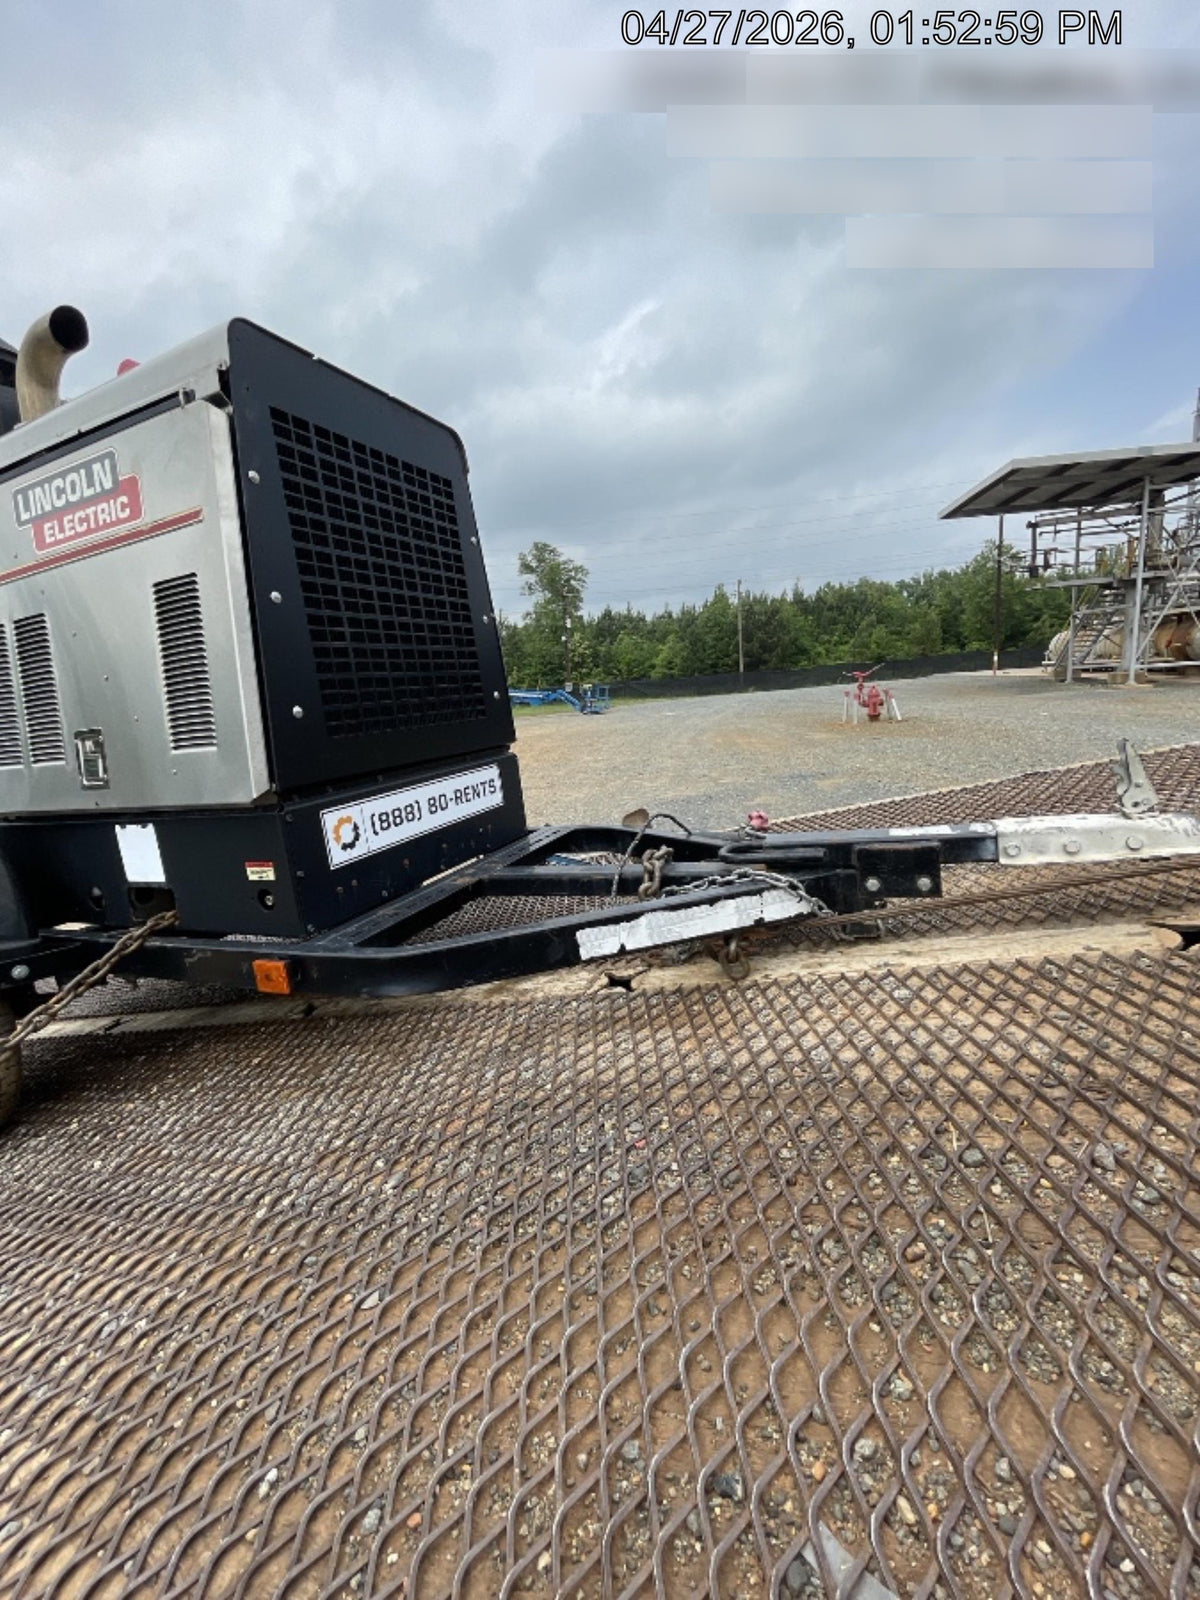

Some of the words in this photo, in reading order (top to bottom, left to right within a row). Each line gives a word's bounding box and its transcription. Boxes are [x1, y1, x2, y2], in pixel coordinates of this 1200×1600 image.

[17, 458, 113, 522] LINCOLN
[43, 495, 130, 544] ELECTRIC
[370, 800, 423, 836] (888)
